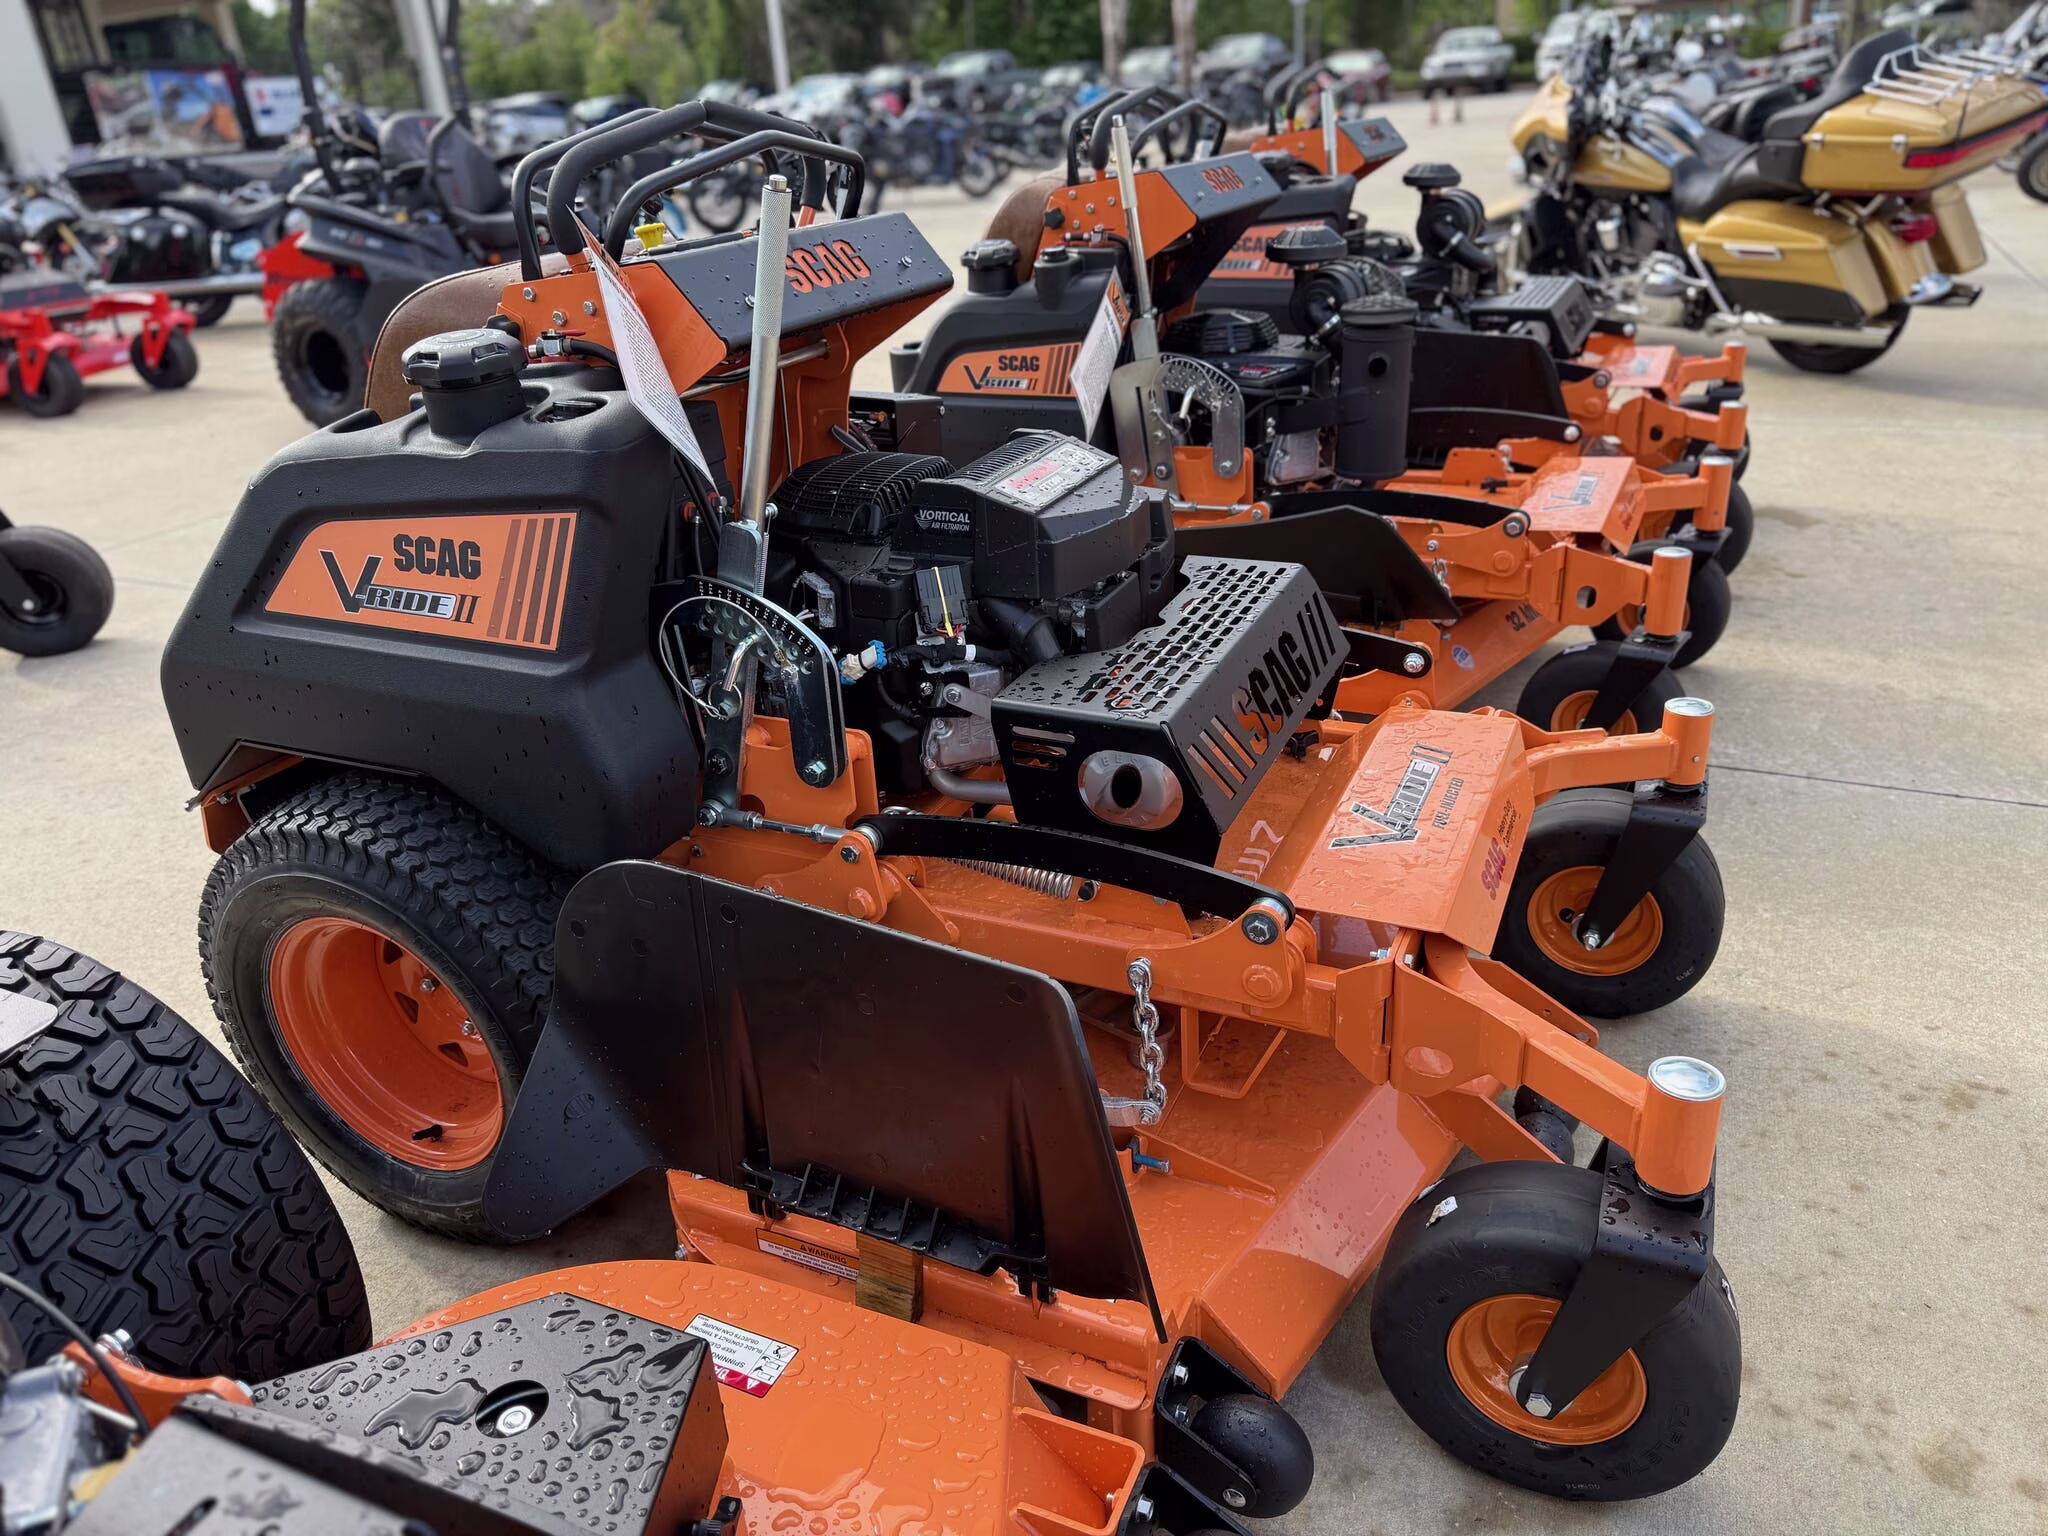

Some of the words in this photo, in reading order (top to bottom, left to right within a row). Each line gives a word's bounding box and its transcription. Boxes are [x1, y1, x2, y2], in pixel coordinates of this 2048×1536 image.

[1201, 165, 1245, 194] SCAG
[785, 239, 872, 294] SCAG
[998, 355, 1040, 372] SCAG
[918, 508, 971, 524] VORTICAL
[930, 521, 942, 531] AIR
[940, 522, 970, 532] FILTRATION
[393, 533, 482, 581] SCAG
[1231, 629, 1312, 756] SCAG
[1431, 776, 1465, 831] FUEL-INJECTED
[1481, 837, 1507, 901] SCAG
[807, 1246, 848, 1264] WARNING
[719, 1335, 745, 1348] CONTACT
